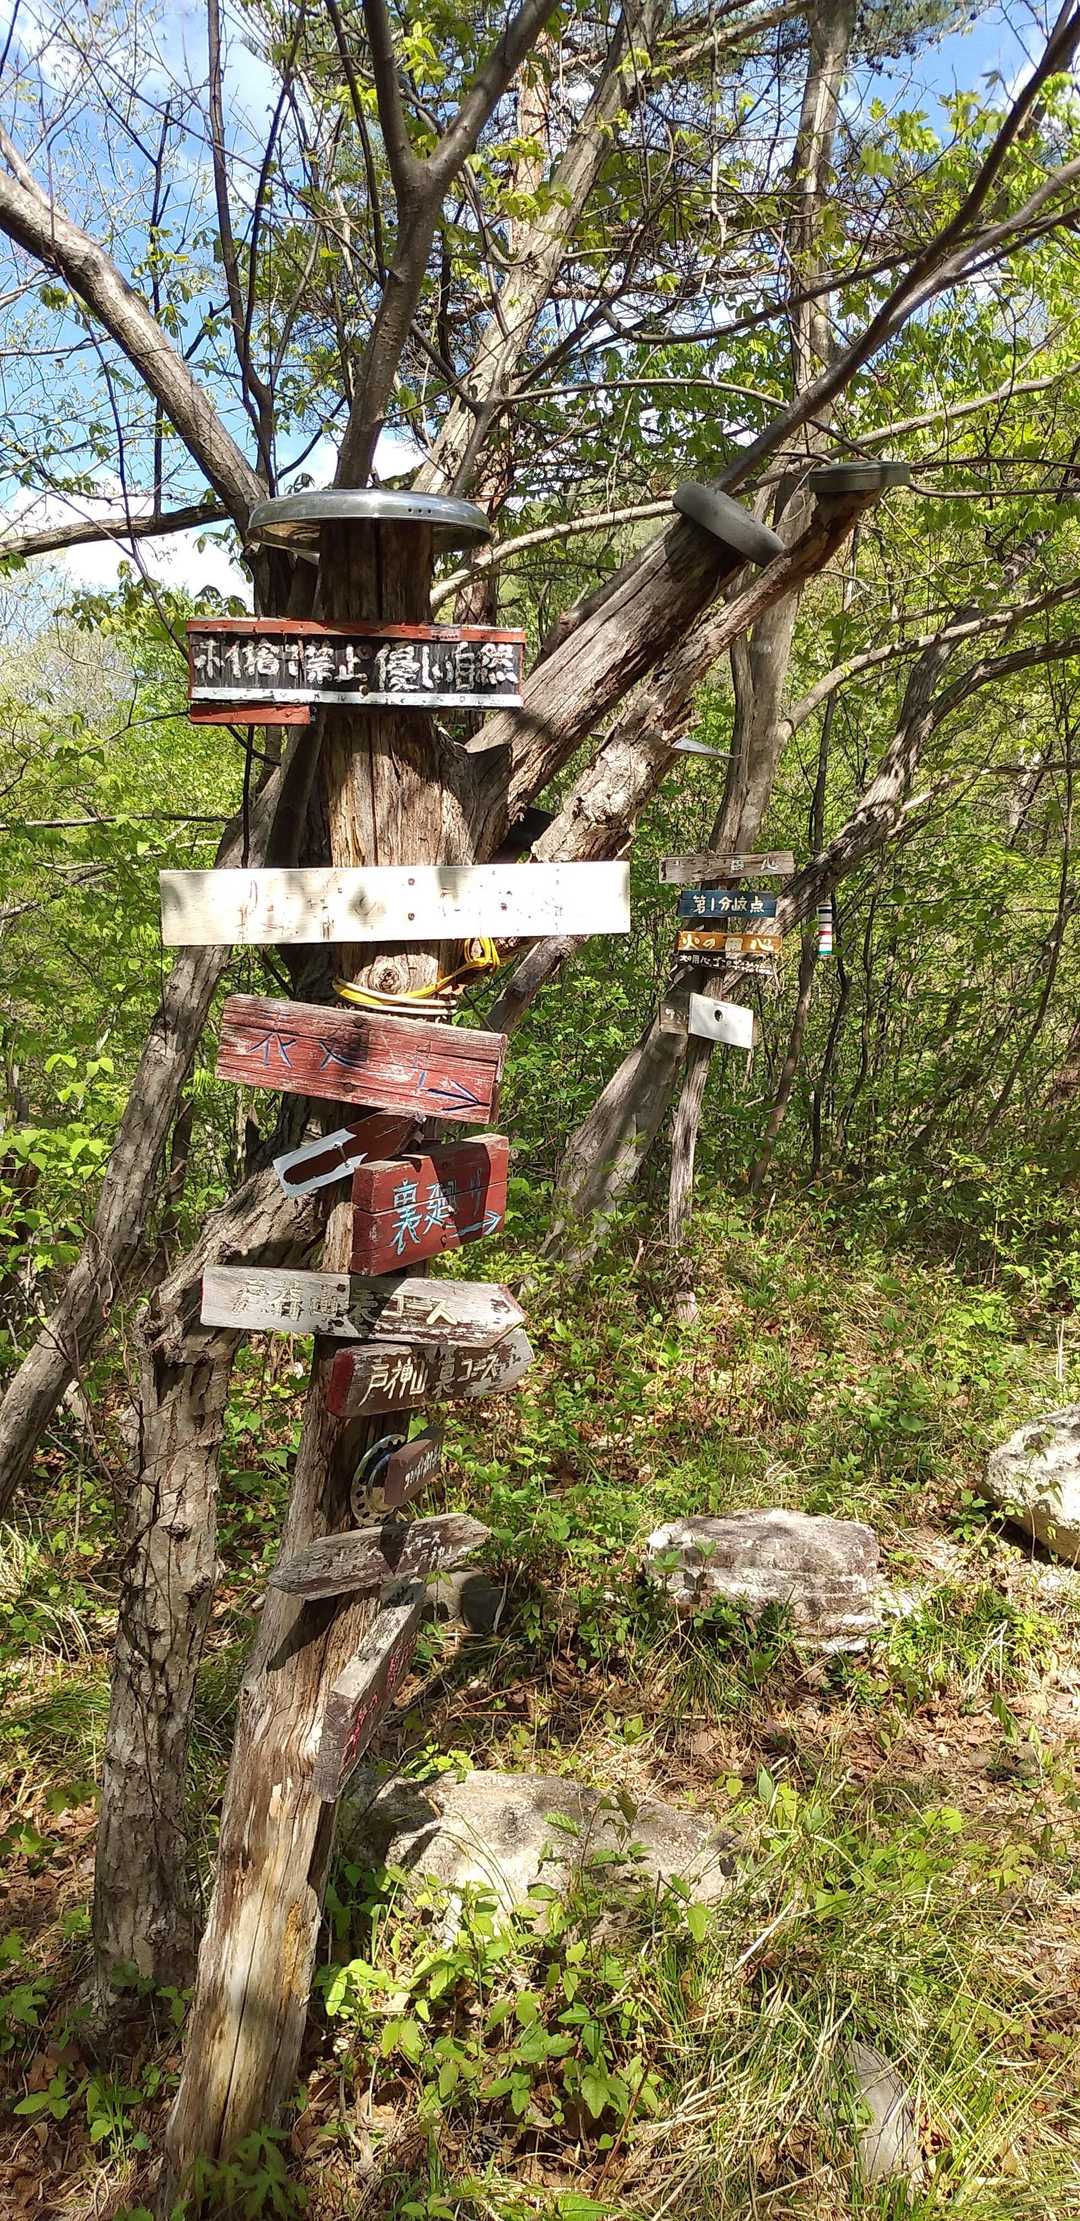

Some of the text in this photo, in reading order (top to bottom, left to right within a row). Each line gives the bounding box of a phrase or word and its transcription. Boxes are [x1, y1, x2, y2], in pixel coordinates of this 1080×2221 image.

[692, 894, 765, 914] 第1分岐点
[358, 1352, 500, 1408] 戸神山裏コース
